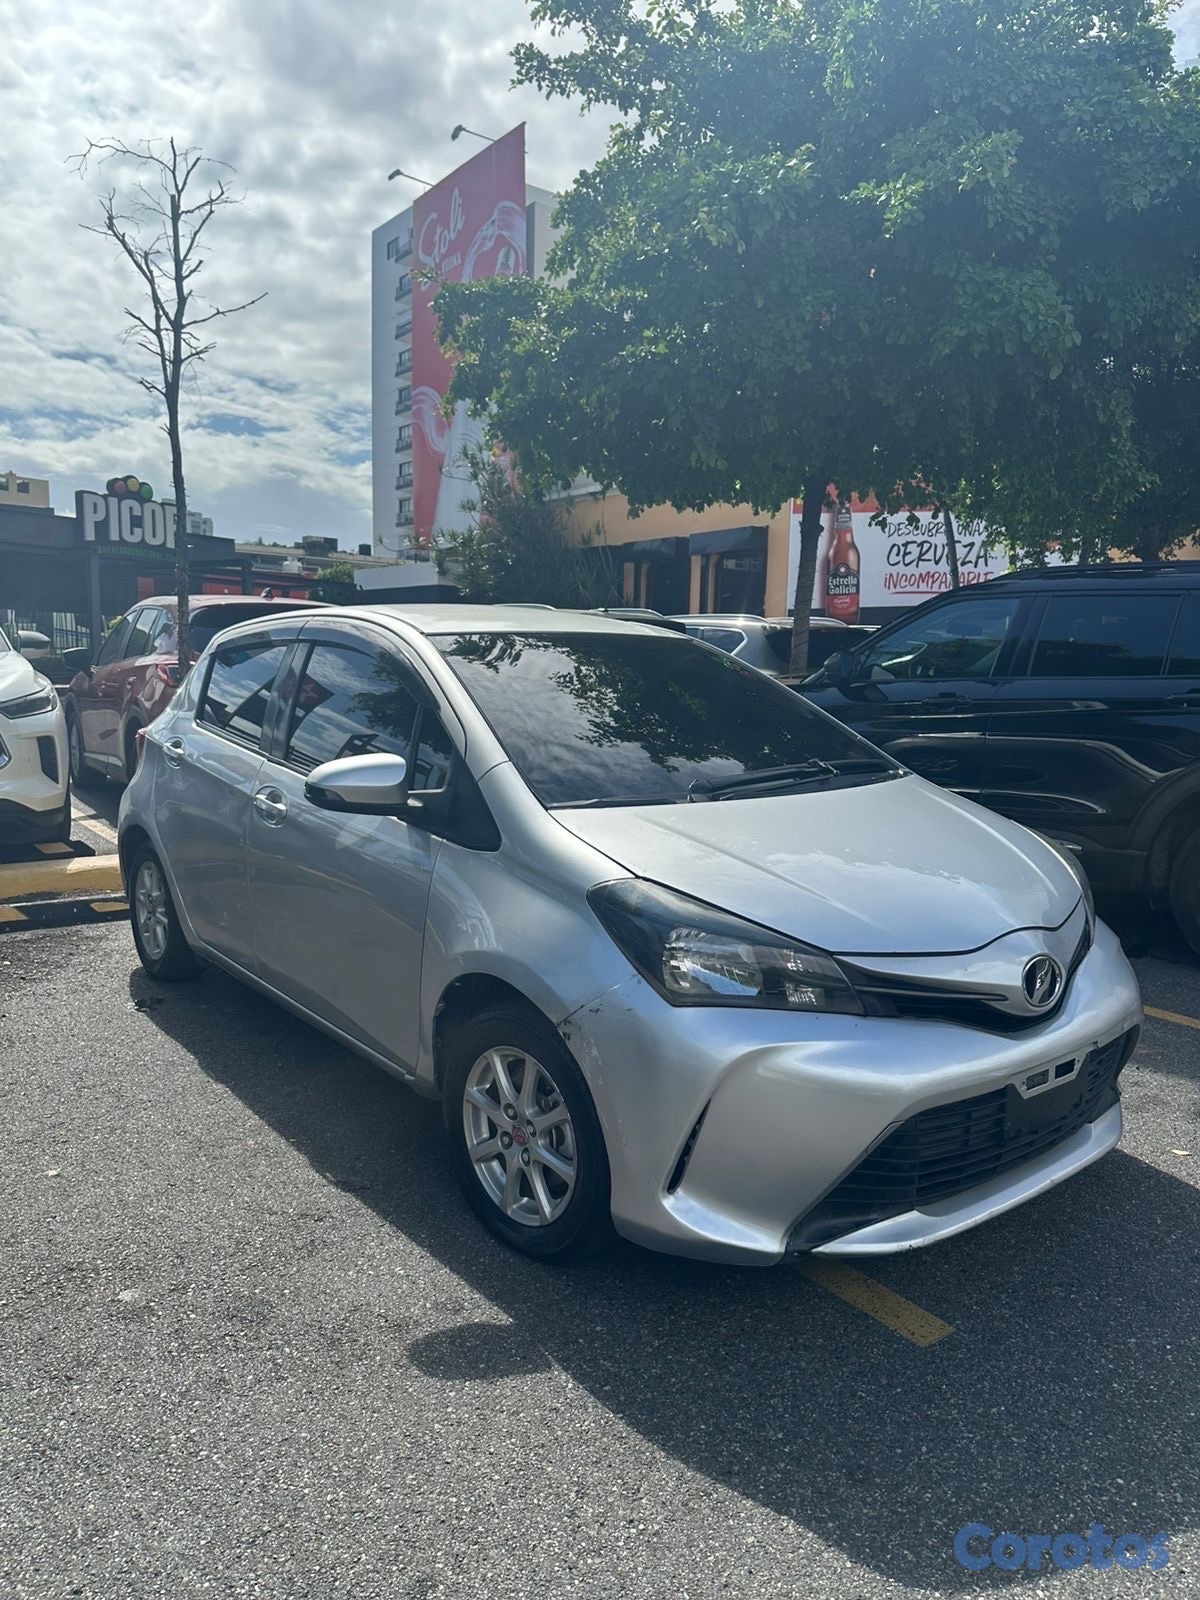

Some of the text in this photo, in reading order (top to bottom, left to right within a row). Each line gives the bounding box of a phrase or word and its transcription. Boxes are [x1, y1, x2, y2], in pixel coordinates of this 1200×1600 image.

[418, 187, 465, 292] Stoli
[887, 521, 946, 538] DESCUBR
[828, 576, 858, 586] Estrella
[828, 585, 857, 595] Galicia
